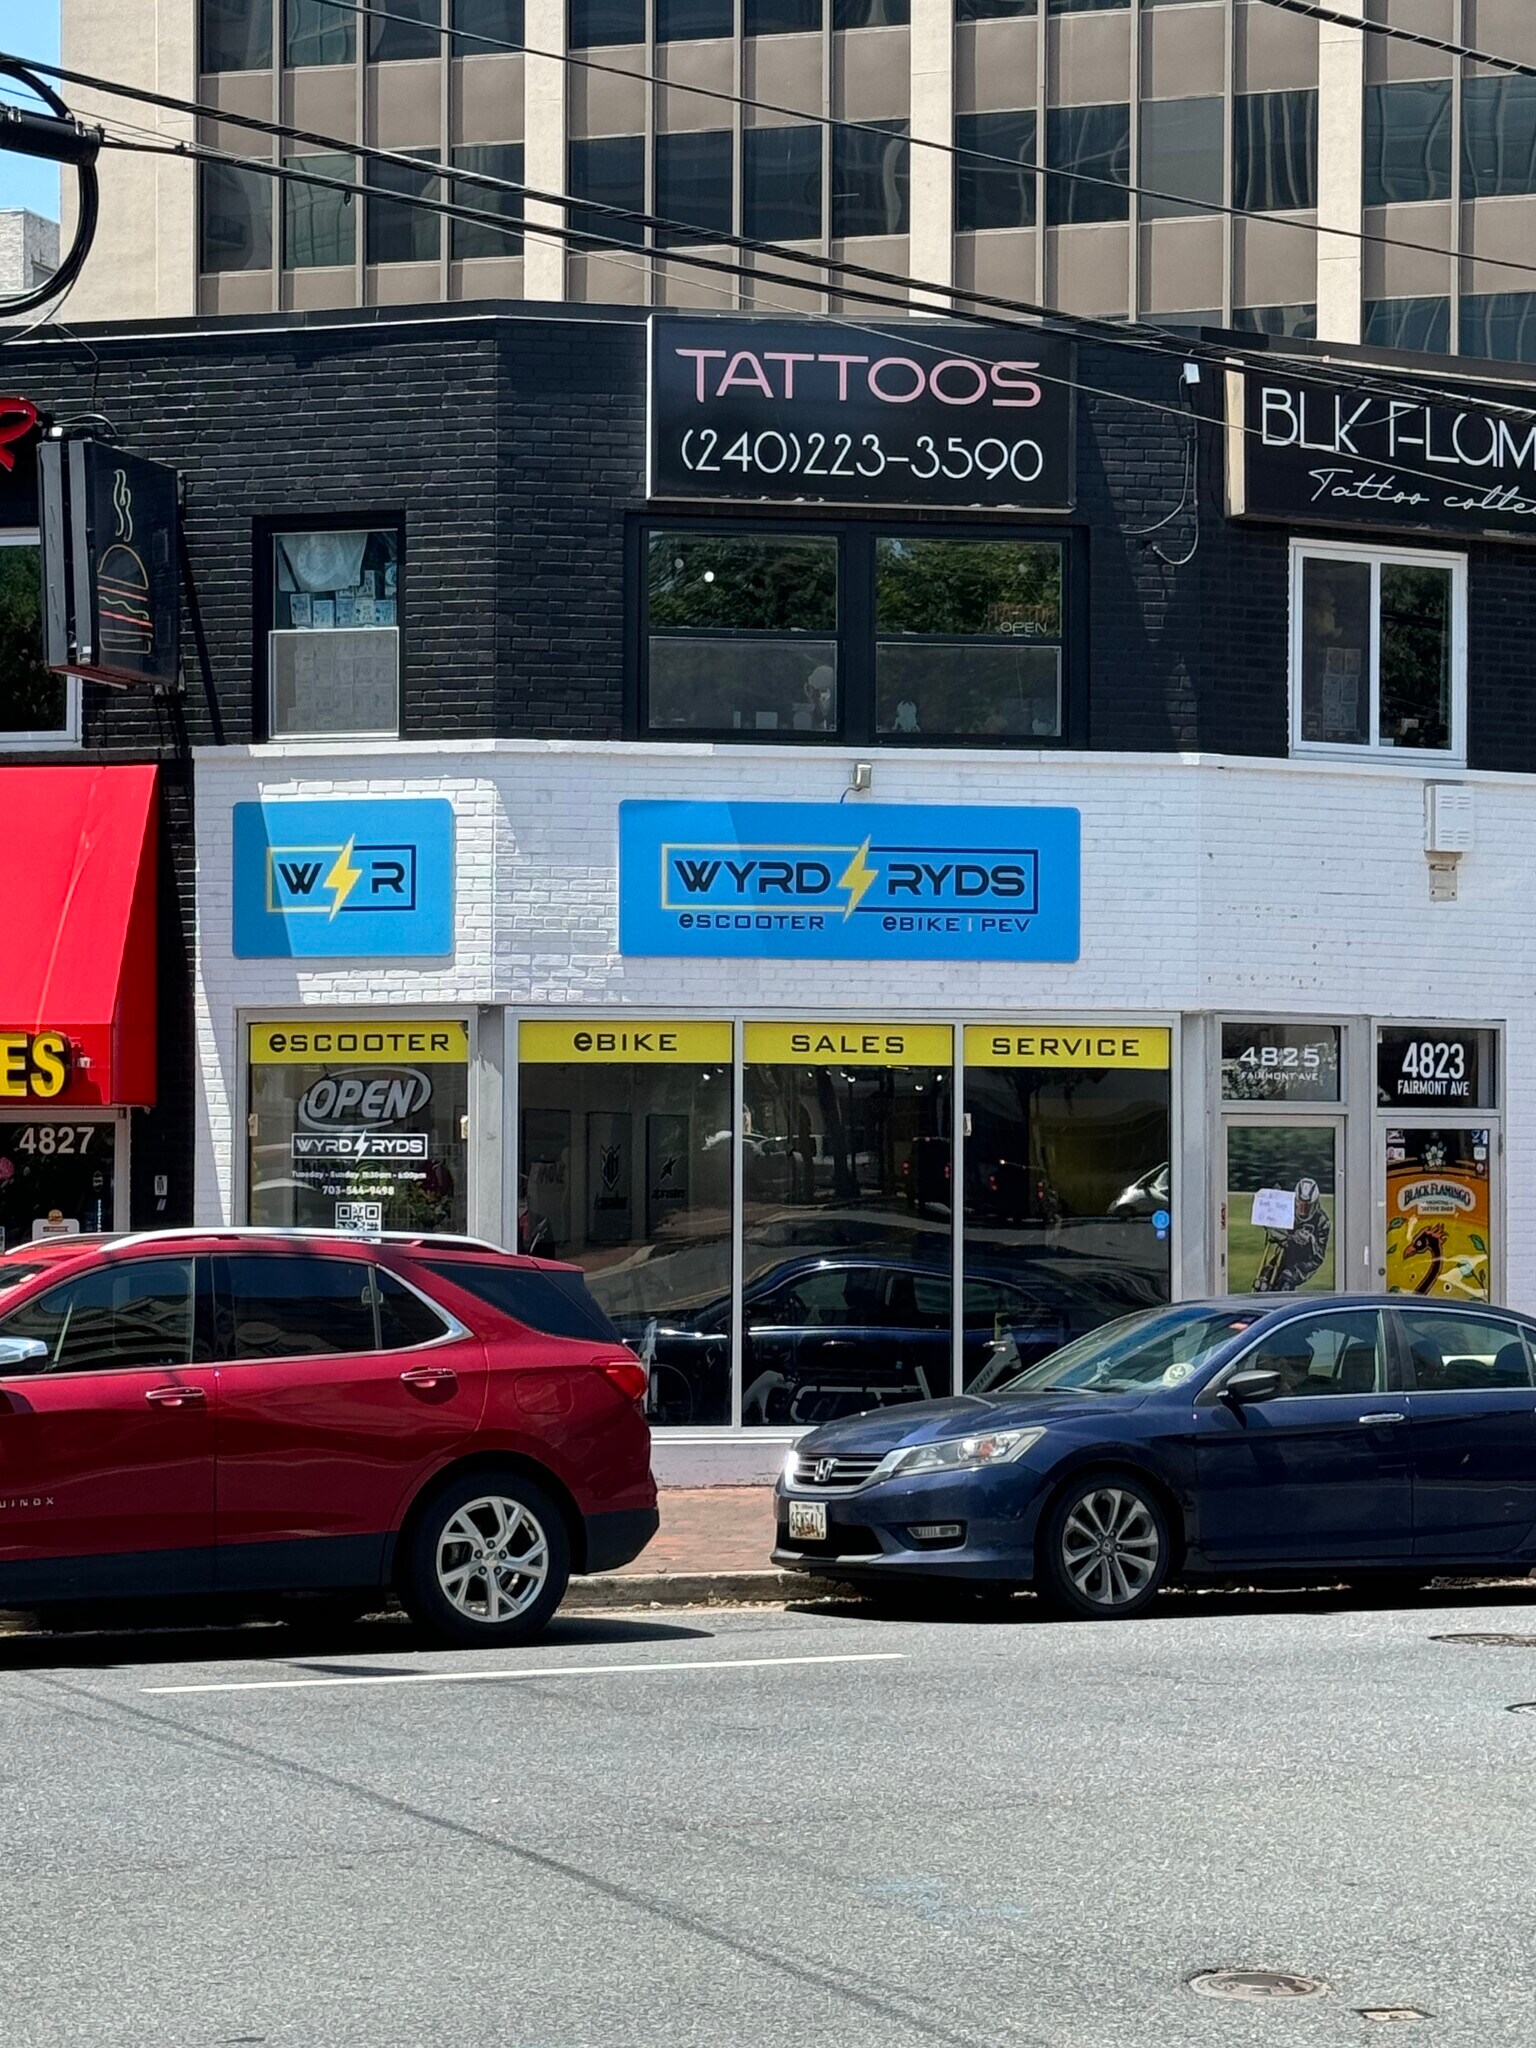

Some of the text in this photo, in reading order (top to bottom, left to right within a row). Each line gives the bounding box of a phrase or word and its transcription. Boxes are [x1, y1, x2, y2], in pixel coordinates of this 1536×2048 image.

[675, 348, 1042, 408] TATTOOS
[1261, 387, 1373, 454] BLK
[681, 428, 1044, 483] (240)223-3590
[1308, 468, 1430, 502] Tattoo
[1000, 621, 1047, 633] OPEN
[278, 861, 406, 895] W R
[674, 859, 1026, 897] WYRD RYDS
[980, 917, 1031, 934] PEV
[790, 1034, 905, 1055] SALES
[991, 1036, 1141, 1058] SERVICE
[1239, 1045, 1321, 1068] 4825
[1402, 1042, 1465, 1080] 4823
[1241, 1071, 1319, 1082] FAIRMONT AVE
[1397, 1080, 1470, 1097] FAIRMONT AVE
[307, 1079, 418, 1119] OPEN
[19, 1126, 95, 1155] 4827
[296, 1139, 423, 1153] WYRD RYDS
[1404, 1182, 1471, 1206] BLACK FLAMINGO
